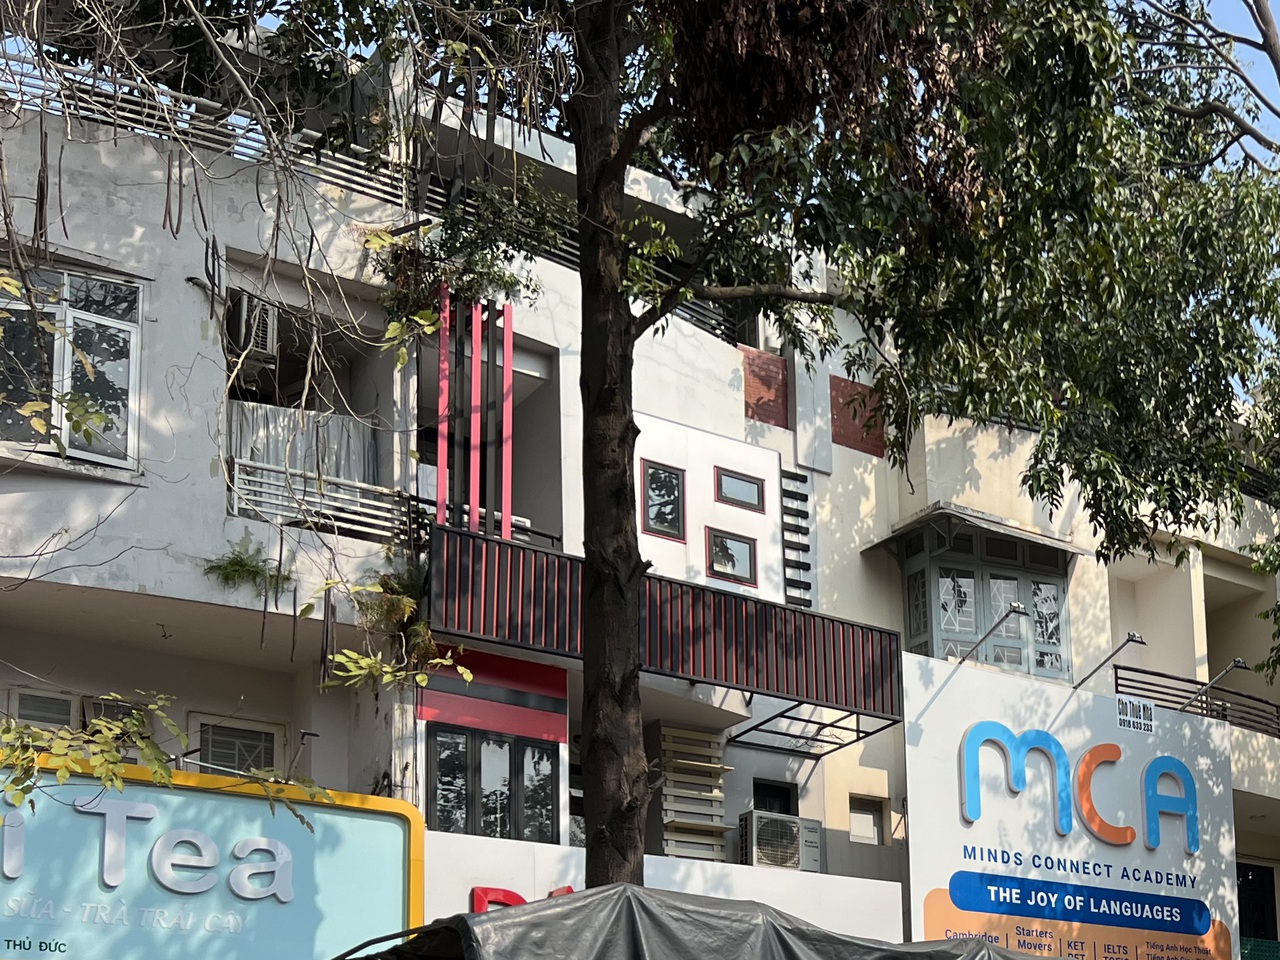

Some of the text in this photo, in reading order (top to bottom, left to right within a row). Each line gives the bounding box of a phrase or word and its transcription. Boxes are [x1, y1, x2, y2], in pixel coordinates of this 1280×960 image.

[1117, 697, 1153, 722] Cho Thuê Nhà
[73, 795, 294, 902] Tea
[963, 844, 1197, 889] MINDS CONNECT ACADEMY
[987, 885, 1181, 922] THE JOY OF LANGUAGES
[81, 898, 129, 927] TRÀ
[140, 903, 193, 930] TRÁI
[204, 909, 248, 934] CÂY
[1015, 926, 1054, 939] Starters
[4, 936, 67, 953] THỦ ĐỨC
[1017, 939, 1053, 952] Movers
[1067, 940, 1086, 951] KET
[1103, 943, 1128, 955] IELTS
[1146, 941, 1164, 952] Tiếng
[1166, 943, 1178, 952] Anh
[1180, 945, 1192, 954] Học
